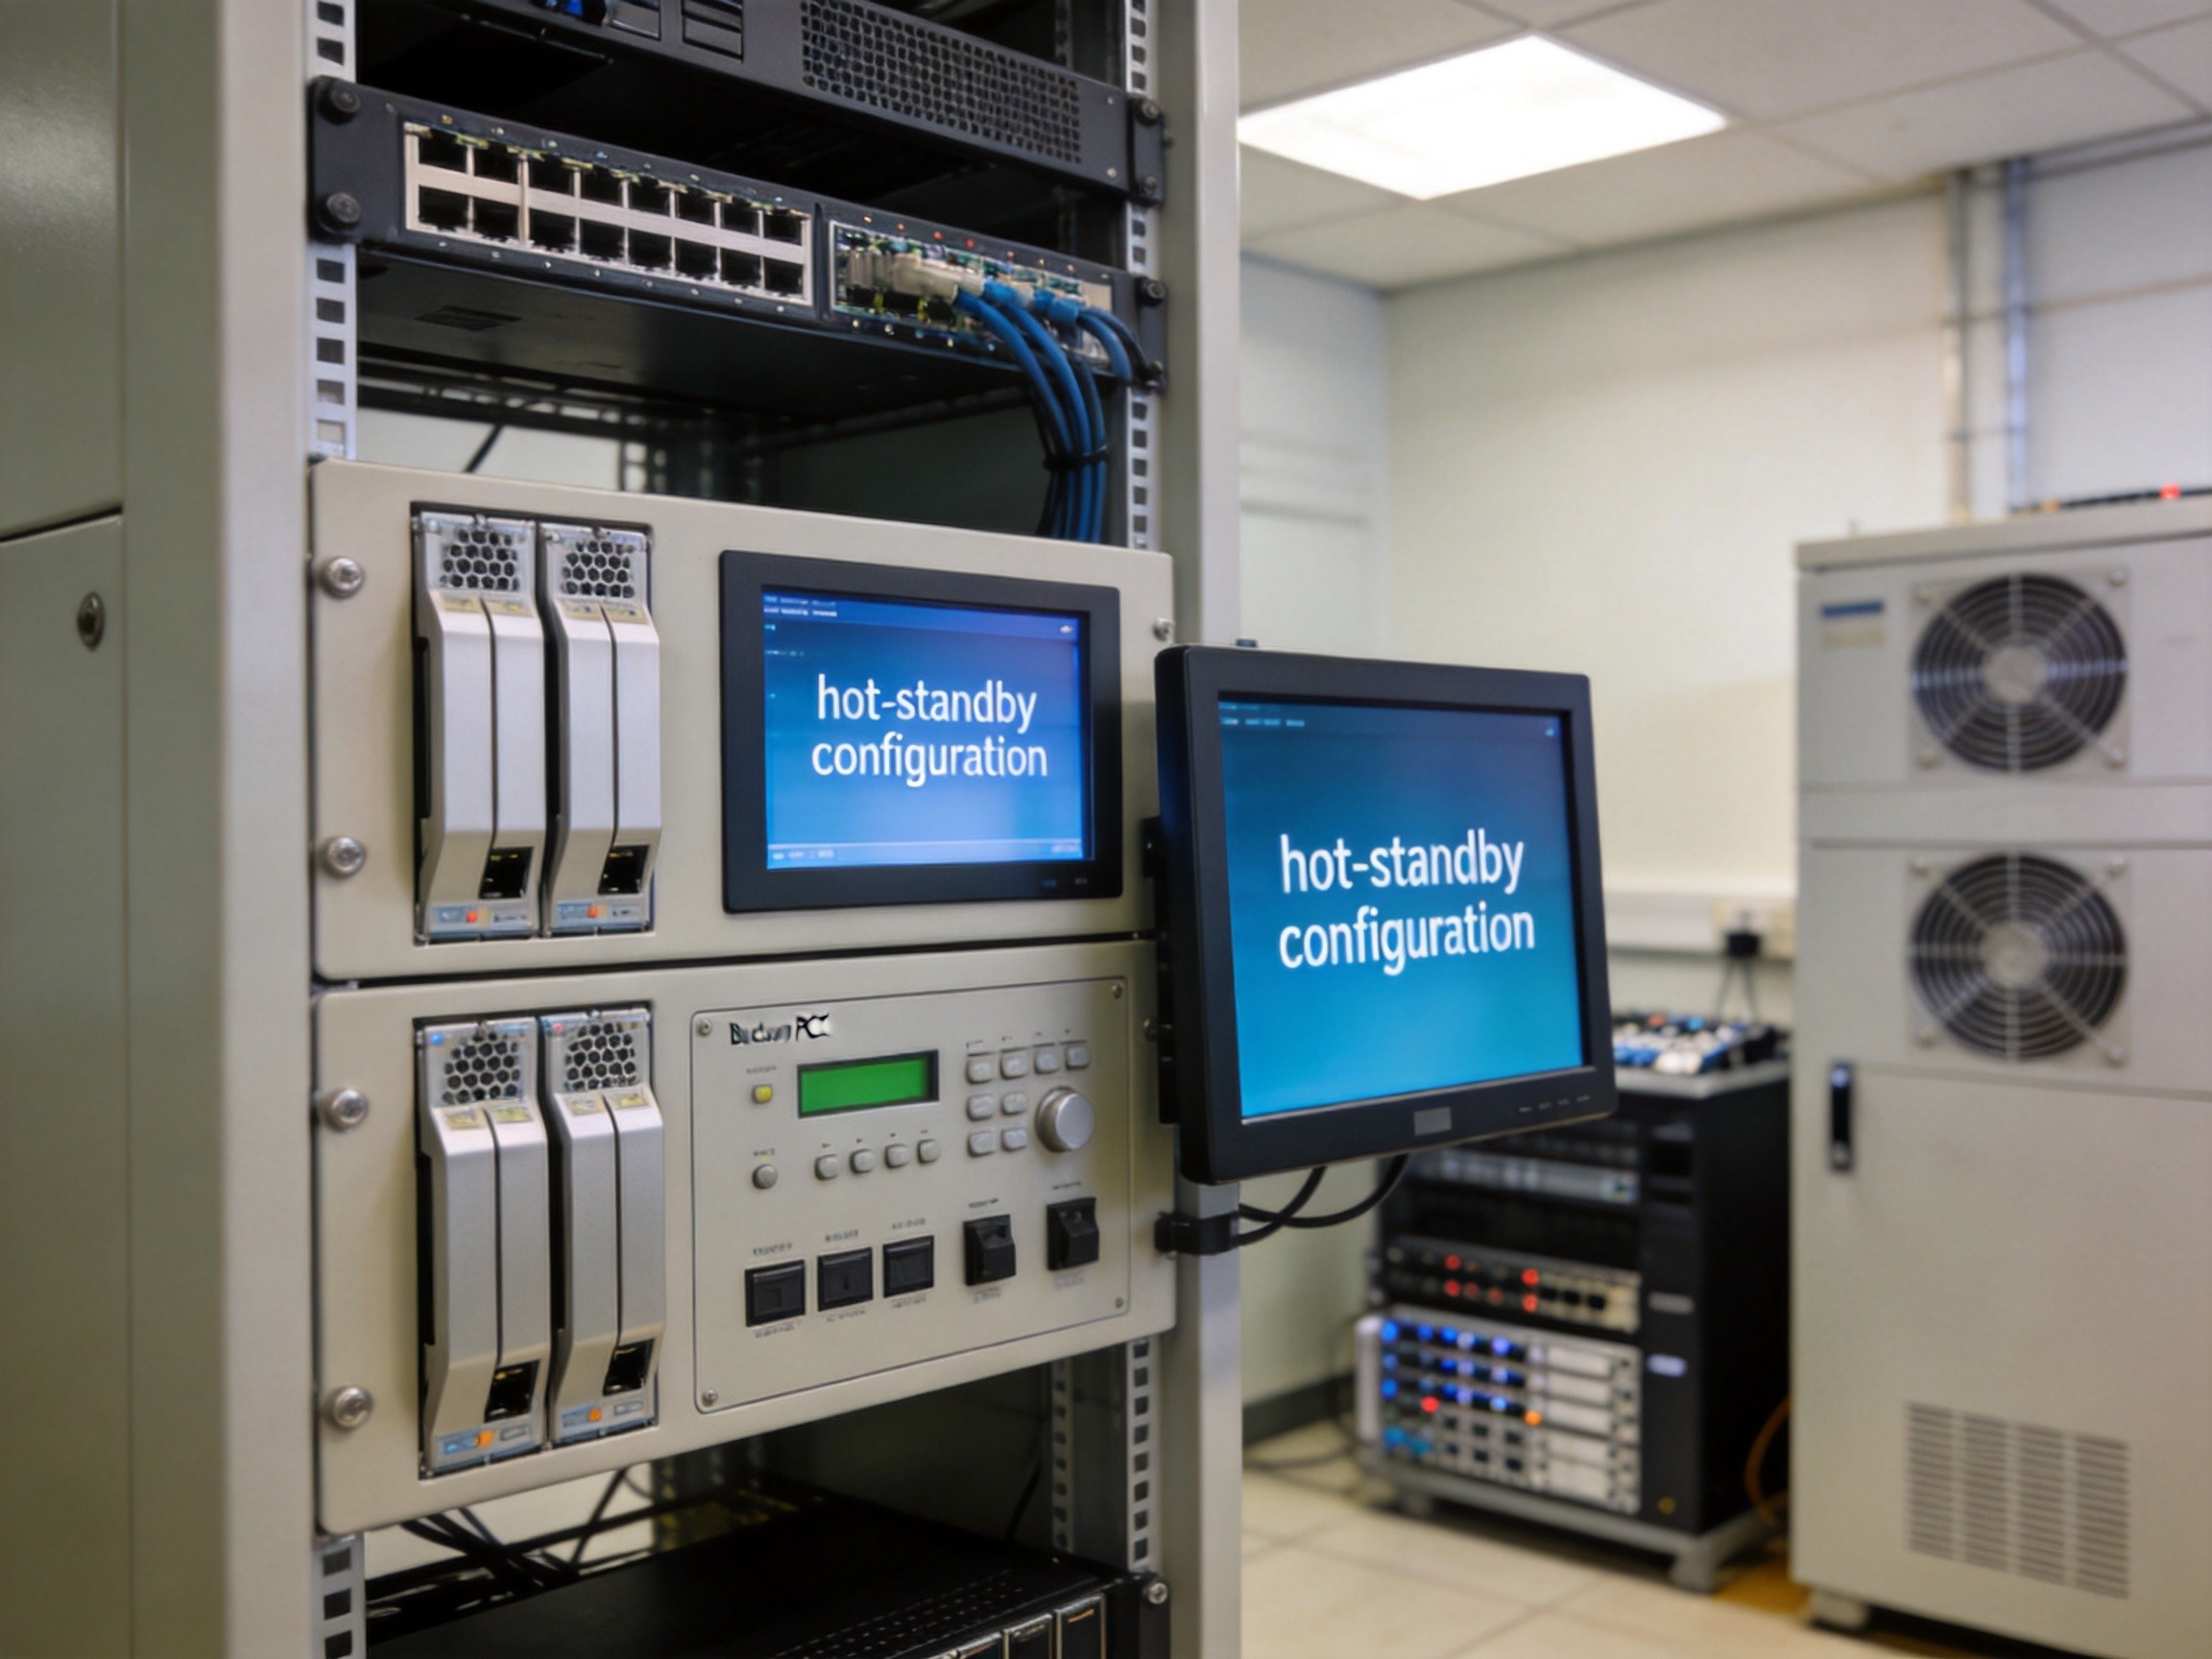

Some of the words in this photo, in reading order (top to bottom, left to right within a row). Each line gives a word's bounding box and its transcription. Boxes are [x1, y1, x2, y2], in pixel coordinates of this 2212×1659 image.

[818, 673, 1037, 735] hot-standby
[812, 731, 1048, 788] configuration
[1280, 828, 1525, 895] hot-standby
[1278, 901, 1535, 977] configuration
